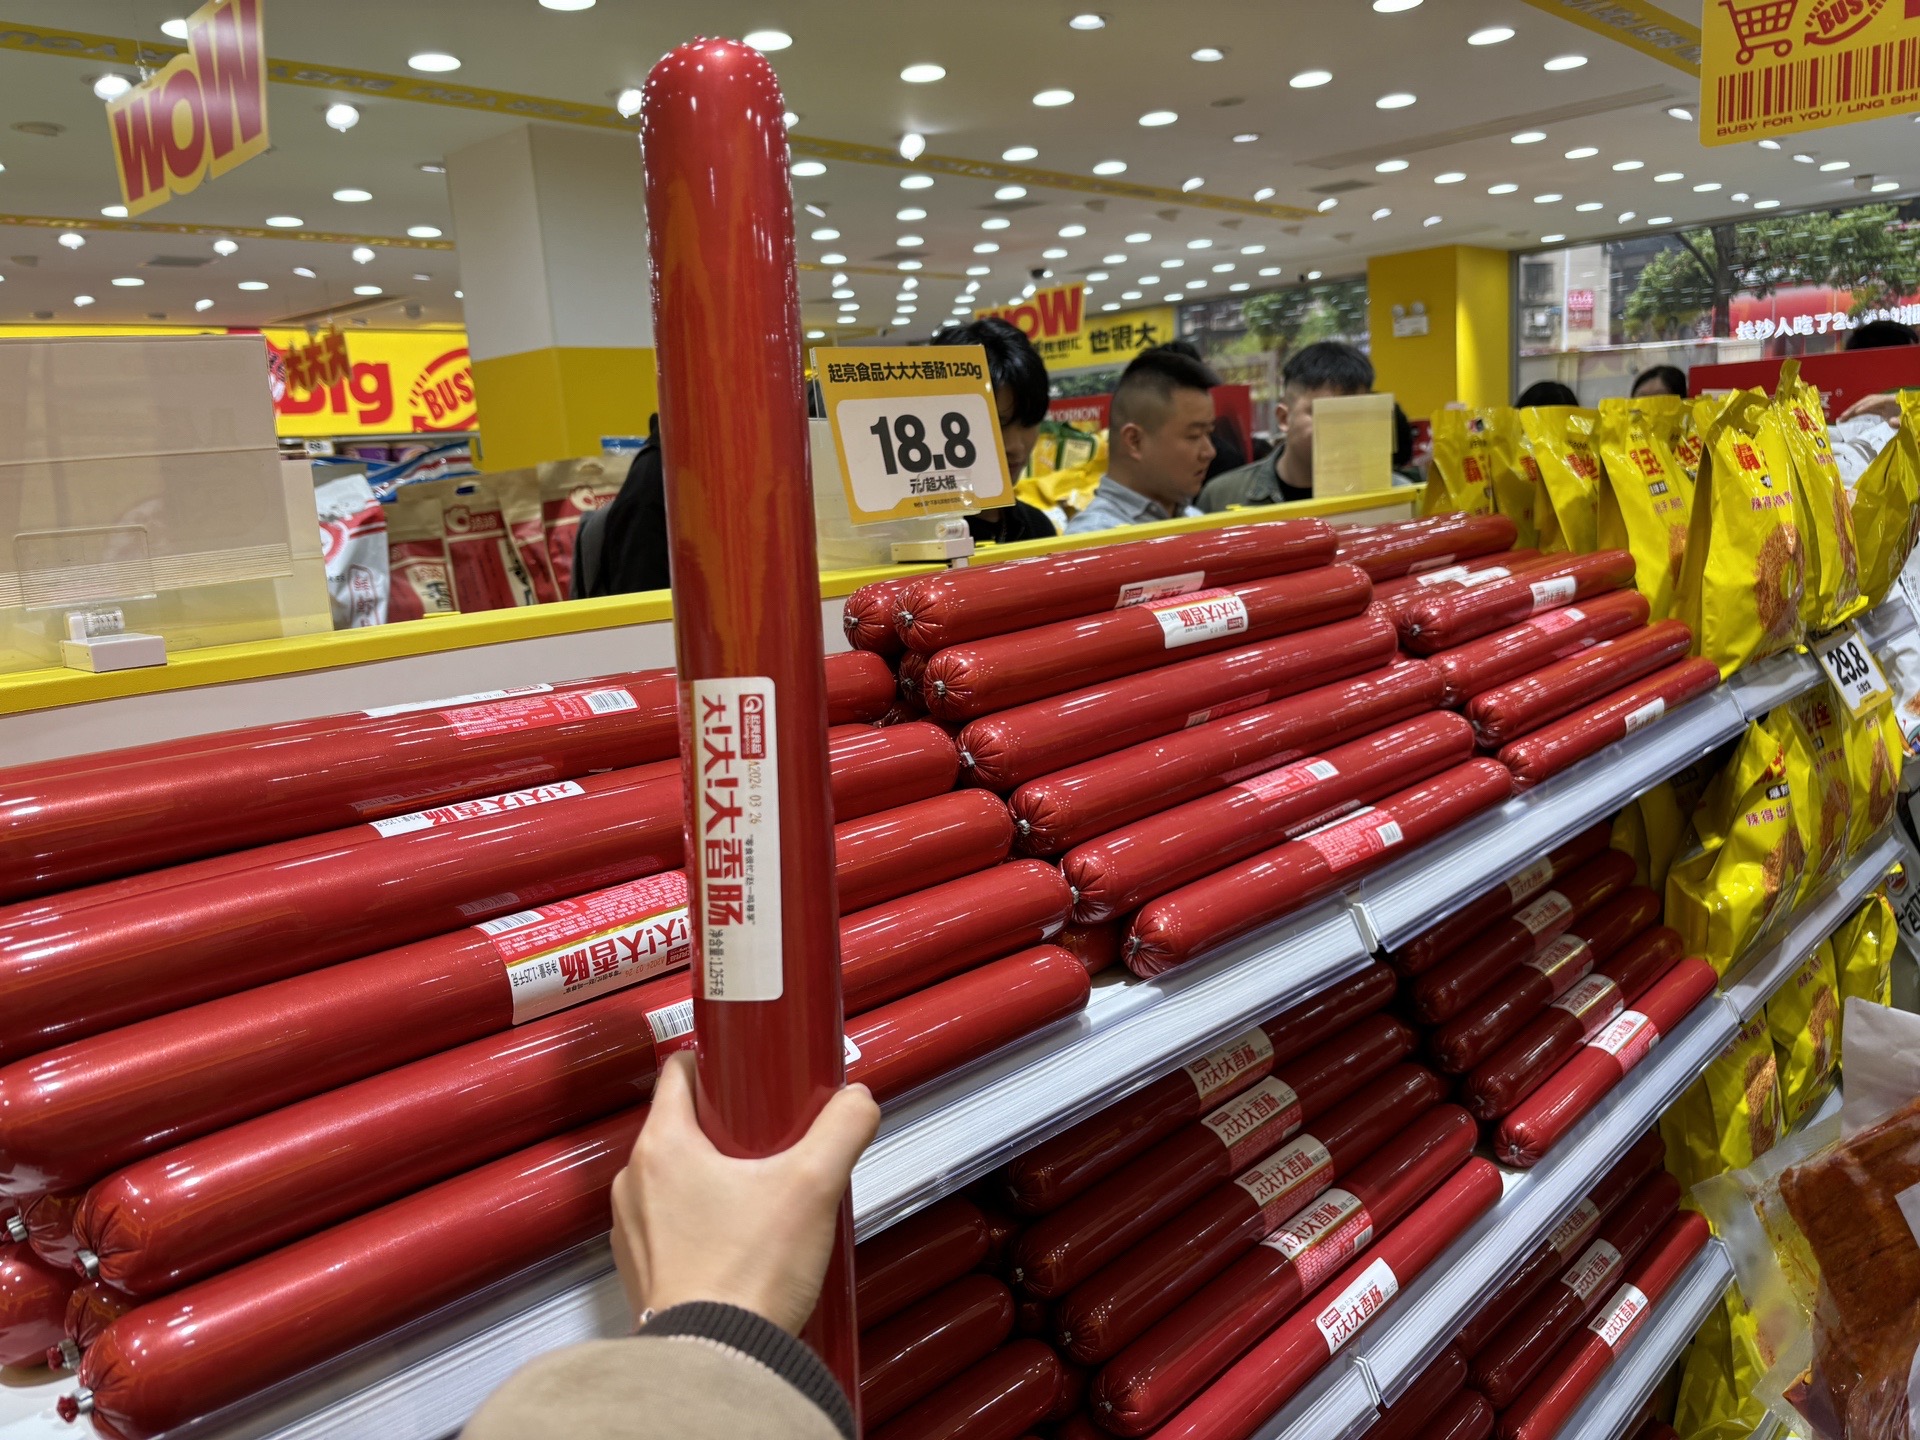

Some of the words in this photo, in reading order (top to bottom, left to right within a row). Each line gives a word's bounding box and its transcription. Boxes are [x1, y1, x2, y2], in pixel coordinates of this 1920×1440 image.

[113, 0, 262, 202] WOW
[1763, 115, 1794, 129] FOR
[1799, 105, 1832, 122] YOU
[1848, 100, 1885, 113] LING
[978, 286, 1082, 341] OW
[828, 361, 983, 384] 起亮食品大大大香肠1250g
[870, 411, 977, 475] 18.8
[1827, 641, 1870, 686] 29.8
[749, 794, 762, 808] 03
[749, 813, 762, 825] 26
